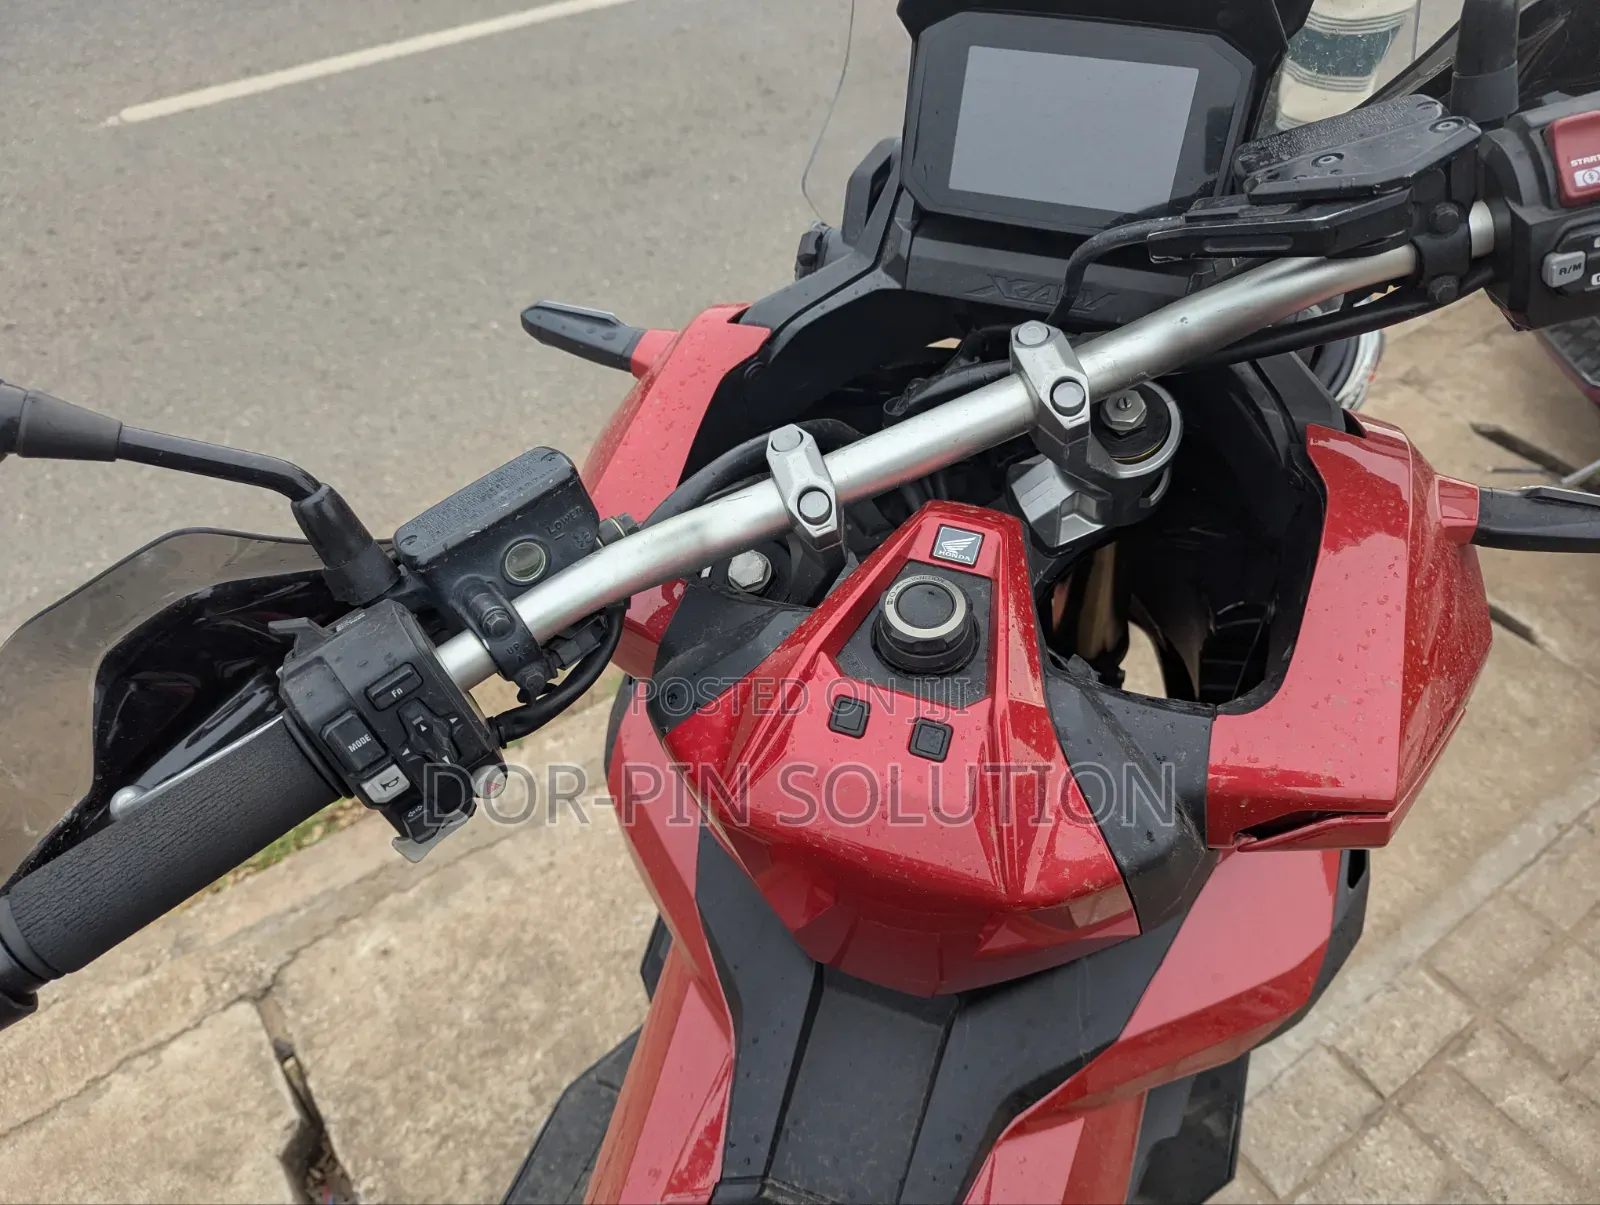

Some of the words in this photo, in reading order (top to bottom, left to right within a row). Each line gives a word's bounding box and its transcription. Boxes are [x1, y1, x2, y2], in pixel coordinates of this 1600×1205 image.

[546, 505, 584, 535] LOWER
[938, 549, 972, 562] HONDA
[391, 686, 404, 699] Fn
[347, 733, 372, 753] MODE
